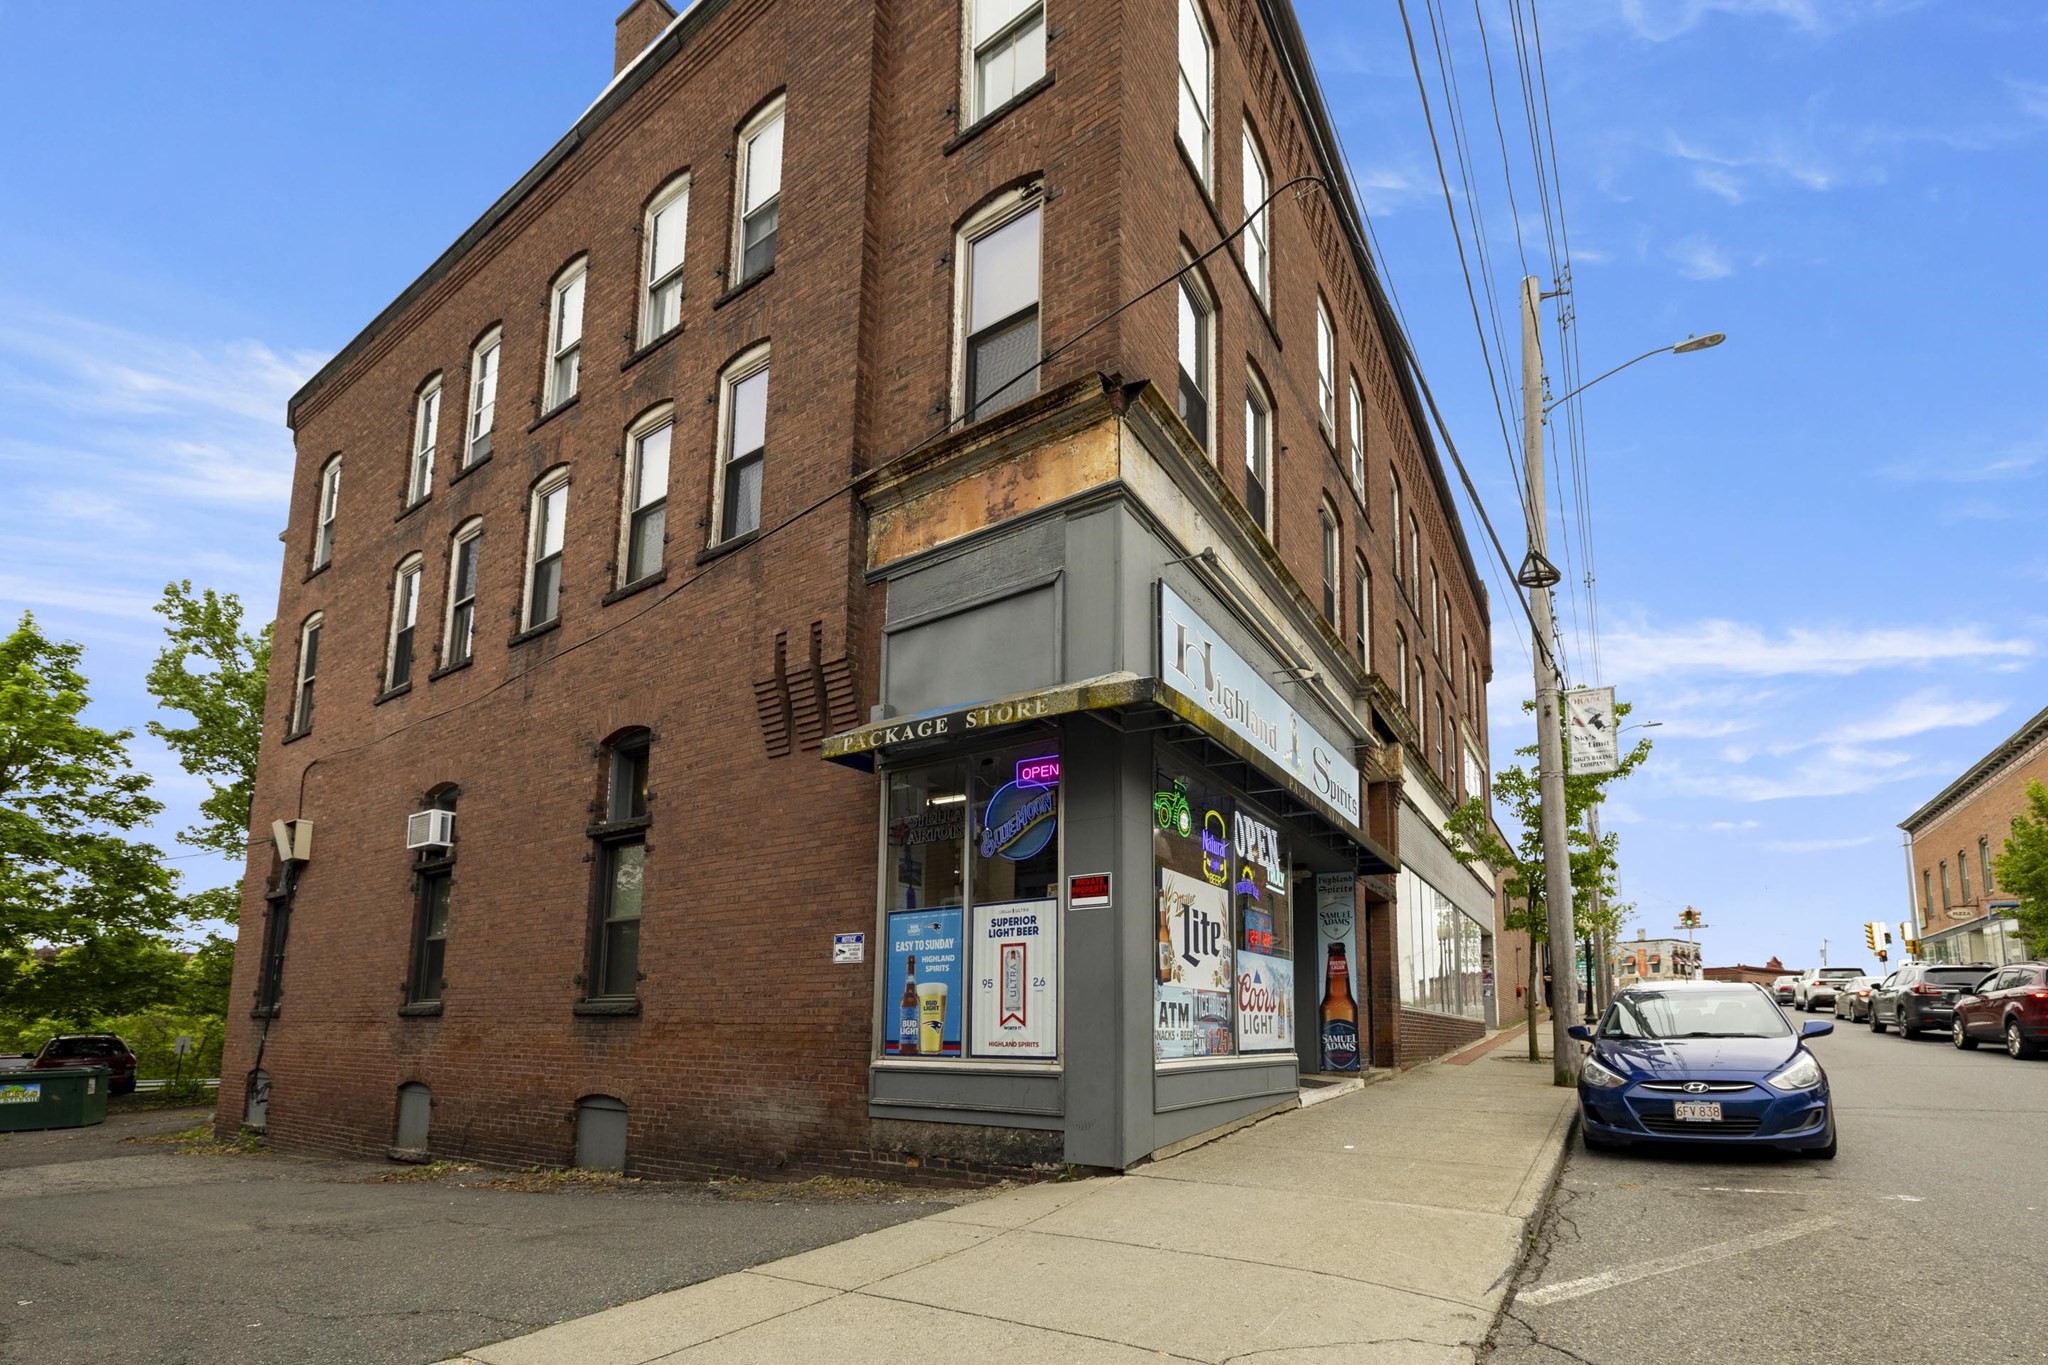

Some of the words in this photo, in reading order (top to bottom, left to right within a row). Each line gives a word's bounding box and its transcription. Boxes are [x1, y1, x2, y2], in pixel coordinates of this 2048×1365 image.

[1168, 611, 1278, 753] Highland
[1312, 745, 1359, 817] Spirits
[842, 717, 949, 752] PACKAGE
[965, 697, 1050, 729] STORE
[1022, 763, 1059, 780] OPEN
[906, 823, 965, 845] ARTOIS
[1202, 828, 1226, 859] Natural
[1234, 810, 1280, 871] OPEN
[1075, 877, 1105, 886] PRIVATE
[1071, 885, 1108, 894] PROPERTY
[1318, 885, 1353, 895] Spirits
[1319, 910, 1353, 920] SAMUEL
[991, 915, 1037, 928] SUPERIOR
[1322, 919, 1351, 927] ADAMS
[988, 928, 1015, 939] LIGHT
[1016, 926, 1039, 936] BEER
[1182, 903, 1221, 967] Lite
[895, 941, 913, 952] EASY
[915, 940, 924, 950] TO
[925, 938, 955, 950] SUNDAY
[921, 955, 956, 963] HIGHLAND
[925, 964, 950, 973] SPIRITS
[981, 978, 994, 989] 95
[1009, 963, 1017, 998] ULTRA
[1032, 976, 1046, 987] 2.6
[1237, 973, 1277, 1013] Coors
[1158, 1001, 1190, 1029] ATM
[902, 1020, 917, 1028] BUD
[1243, 1014, 1273, 1035] LIGHT
[900, 1027, 919, 1035] LIGHT
[1181, 1030, 1193, 1041] BEER
[1321, 1034, 1358, 1044] SAMUEL
[1324, 1042, 1356, 1052] ADAMS
[1677, 1106, 1696, 1117] 6FV
[1699, 1106, 1720, 1117] 838
